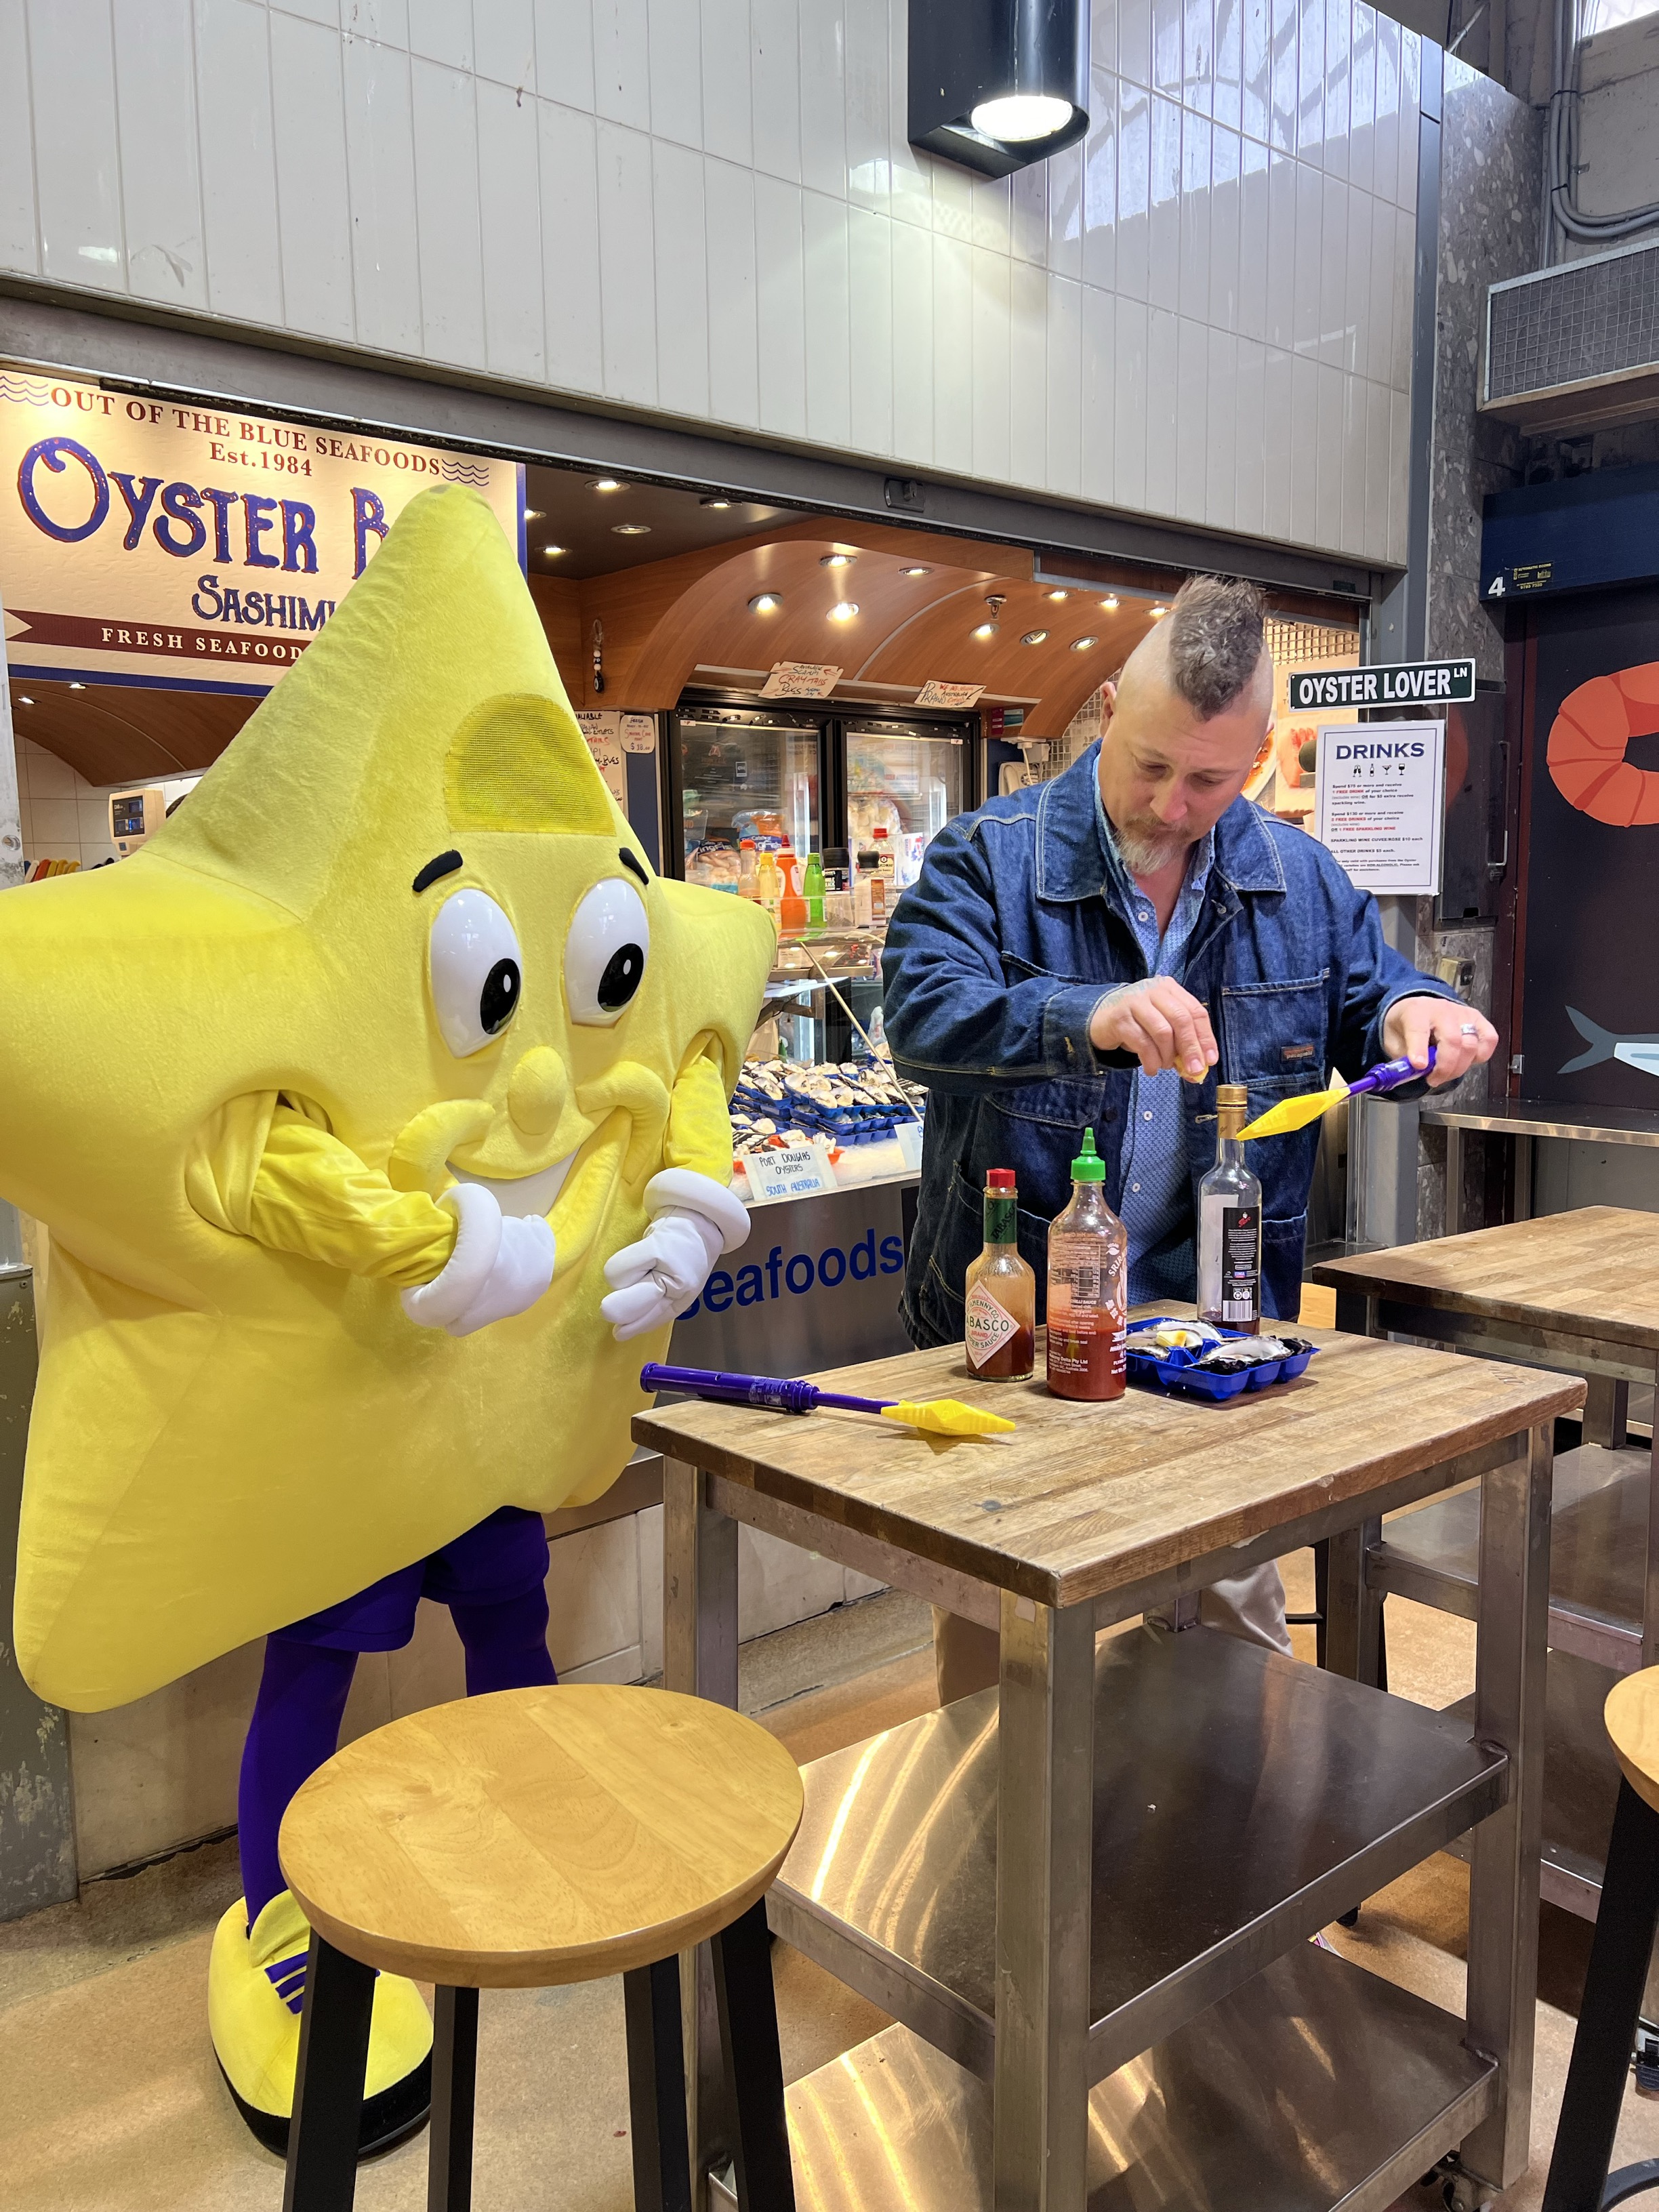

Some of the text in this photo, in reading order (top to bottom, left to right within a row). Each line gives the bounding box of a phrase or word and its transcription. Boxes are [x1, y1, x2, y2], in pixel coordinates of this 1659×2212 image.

[52, 387, 441, 475] OUT OF THE BLUE SEAFOODS
[209, 442, 312, 476] Est.1984
[17, 436, 319, 574] OYSTER
[1488, 576, 1506, 596] 4
[101, 628, 183, 649] FRESH
[1299, 674, 1378, 704] OYSTER
[1383, 668, 1452, 699] LOVER
[1454, 667, 1468, 678] LN
[1336, 742, 1425, 760] DRINKS
[759, 1151, 811, 1167] PORT DOUGLAS
[775, 1164, 804, 1174] OYSTERS
[766, 1178, 820, 1197] SOUTH AUSTRALIA
[966, 1315, 1009, 1332] ABASCO
[981, 1332, 1000, 1349] SAUCE
